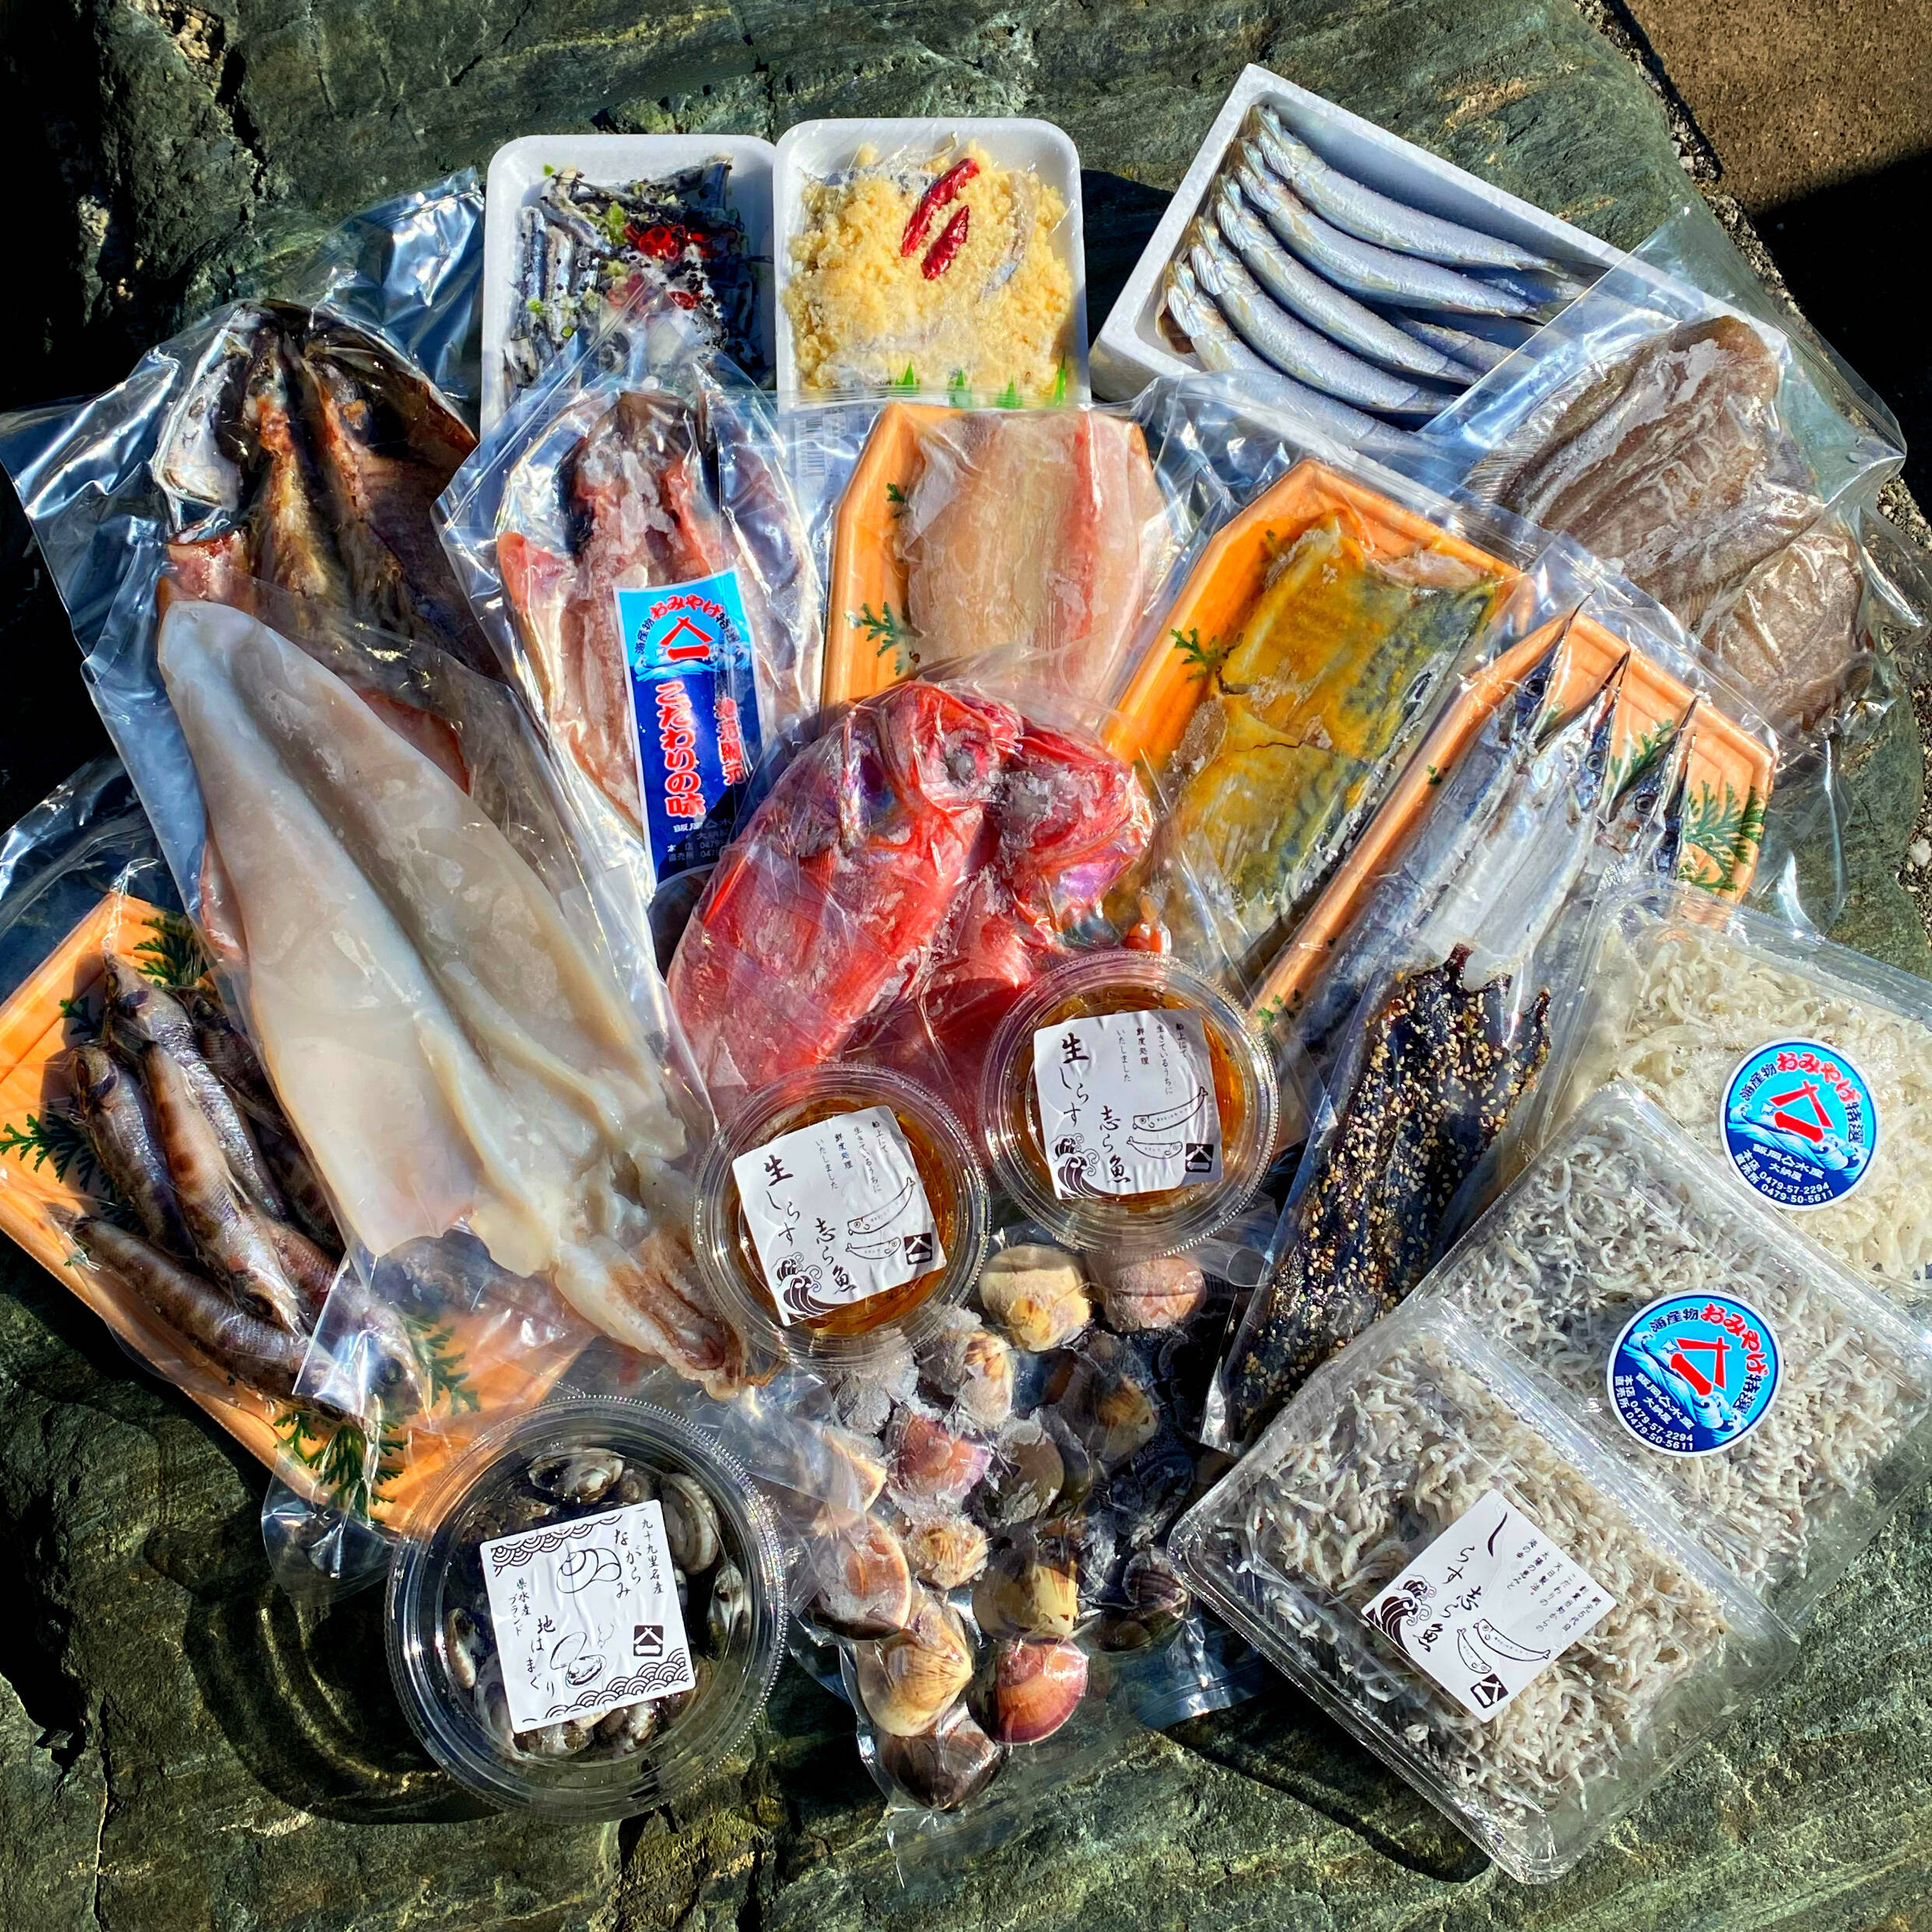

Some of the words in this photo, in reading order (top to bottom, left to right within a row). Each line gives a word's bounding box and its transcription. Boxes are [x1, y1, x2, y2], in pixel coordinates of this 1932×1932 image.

[654, 679, 707, 818] こだわりの味
[1115, 1029, 1131, 1082] いたしました
[1136, 1026, 1151, 1065] 鮮度処理
[1156, 1025, 1174, 1095] 生きているうちに
[1059, 1033, 1089, 1127] 生しらす
[815, 1139, 839, 1190] いたしました
[854, 1126, 882, 1194] 生きているうちに
[1099, 1105, 1131, 1183] 志ら魚
[763, 1155, 801, 1247] 生しらす
[1758, 1172, 1830, 1194] 0479-57-2294
[1761, 1183, 1834, 1204] 0479-50-5611
[815, 1218, 857, 1295] 志ら魚
[1625, 1411, 1694, 1451] 0479-50-5611
[1630, 1400, 1694, 1442] 0479-57-2294
[641, 1519, 664, 1594] 九十九里名産
[1443, 1511, 1509, 1584] しらす
[509, 1593, 523, 1636] ブランド
[1414, 1585, 1482, 1653] 志ら魚
[1539, 1573, 1576, 1607] こだわりの
[526, 1615, 556, 1699] 地はまぐり
